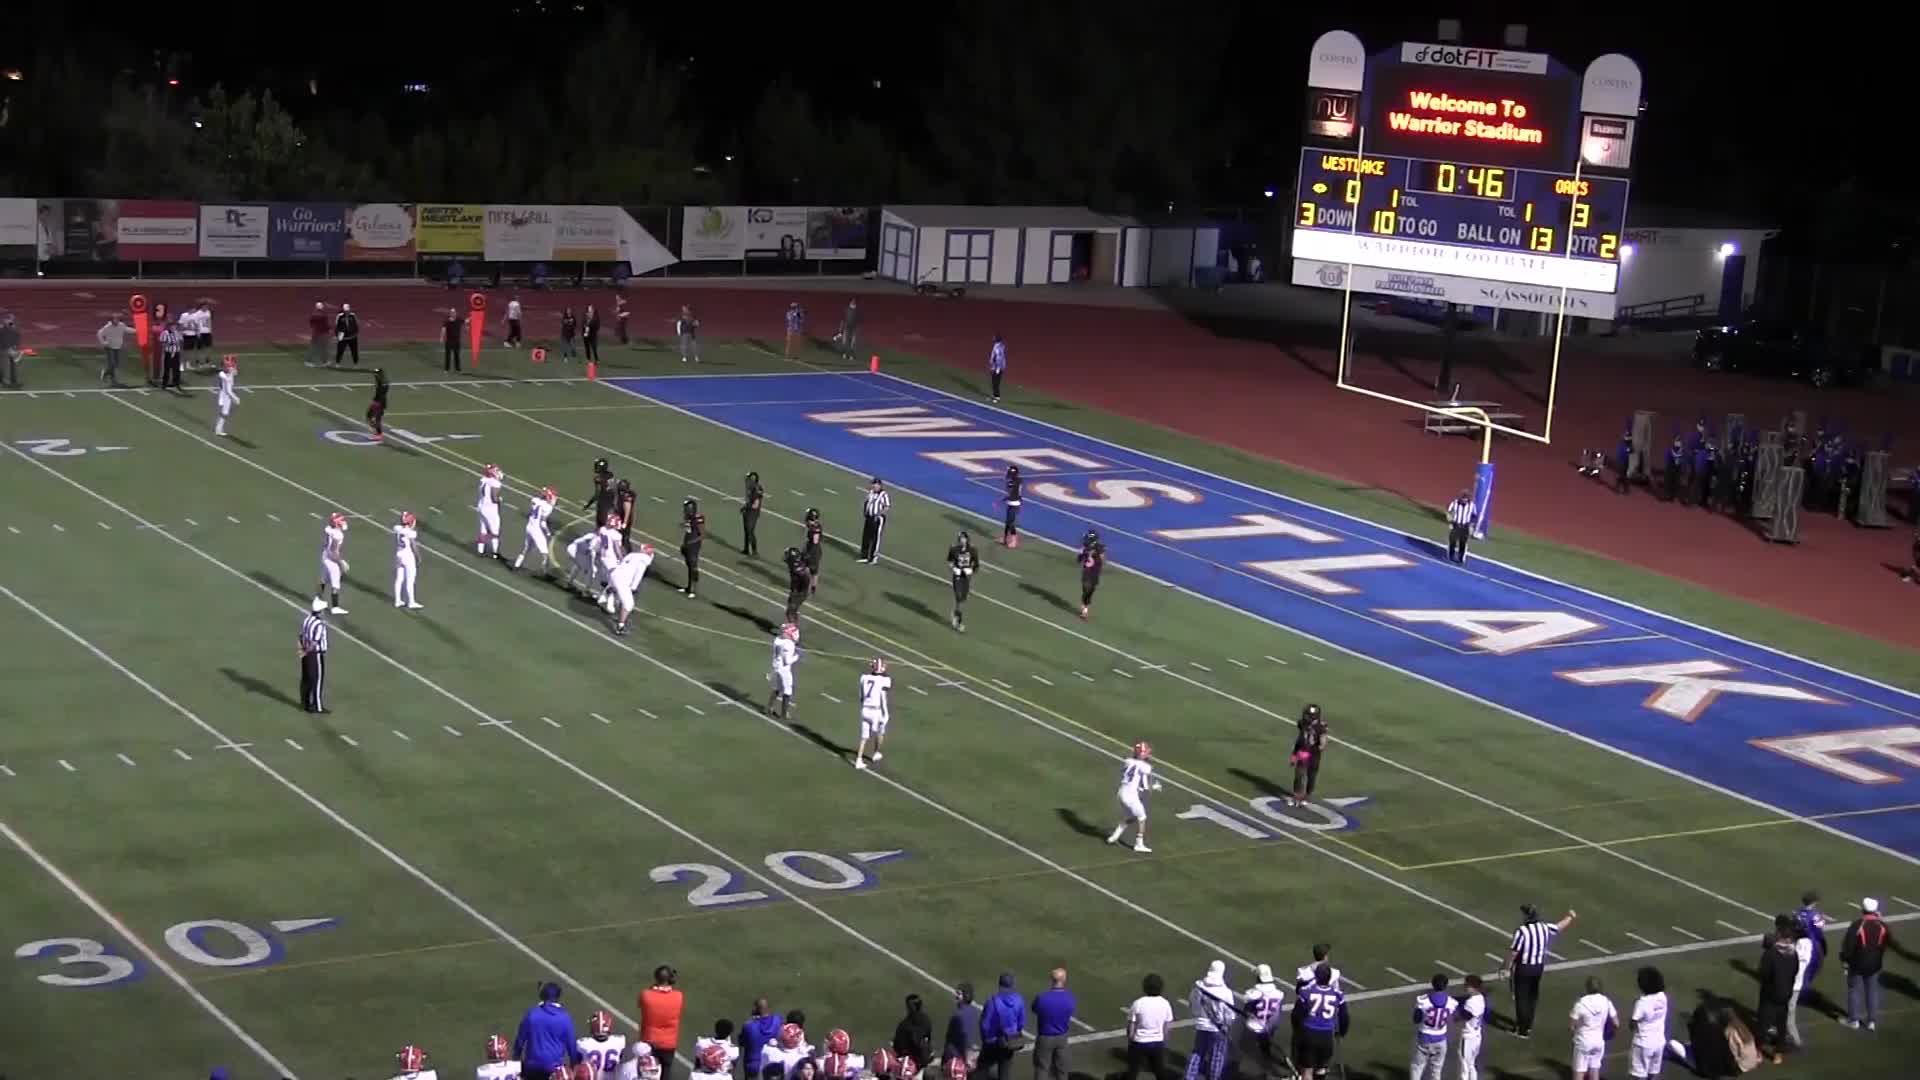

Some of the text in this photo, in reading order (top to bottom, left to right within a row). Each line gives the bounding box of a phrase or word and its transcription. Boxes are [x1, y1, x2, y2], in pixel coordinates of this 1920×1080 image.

[1430, 47, 1498, 71] dotFIT
[1410, 91, 1527, 119] Welcome To
[1389, 112, 1542, 144] Warrior Stadium
[1322, 155, 1385, 176] WESTLAKE
[1346, 180, 1361, 203] 0
[1437, 164, 1504, 198] 0:46
[1555, 179, 1590, 196] OAKS
[1391, 189, 1419, 208] 1 TOL
[276, 217, 342, 232] Warriors!
[292, 207, 313, 221] Go
[1300, 202, 1355, 226] 3 DOWN
[1374, 210, 1438, 237] 10 TO GO
[1498, 203, 1532, 222] TOL 1
[1573, 203, 1590, 228] 3
[1457, 222, 1553, 252] BALL ON 13
[1600, 234, 1618, 259] 2
[803, 405, 1920, 784] WESTLAKE
[867, 680, 876, 698] 7
[1175, 797, 1348, 839] 10
[649, 850, 866, 908] 20
[14, 919, 273, 988] 30
[1309, 993, 1337, 1019] 75
